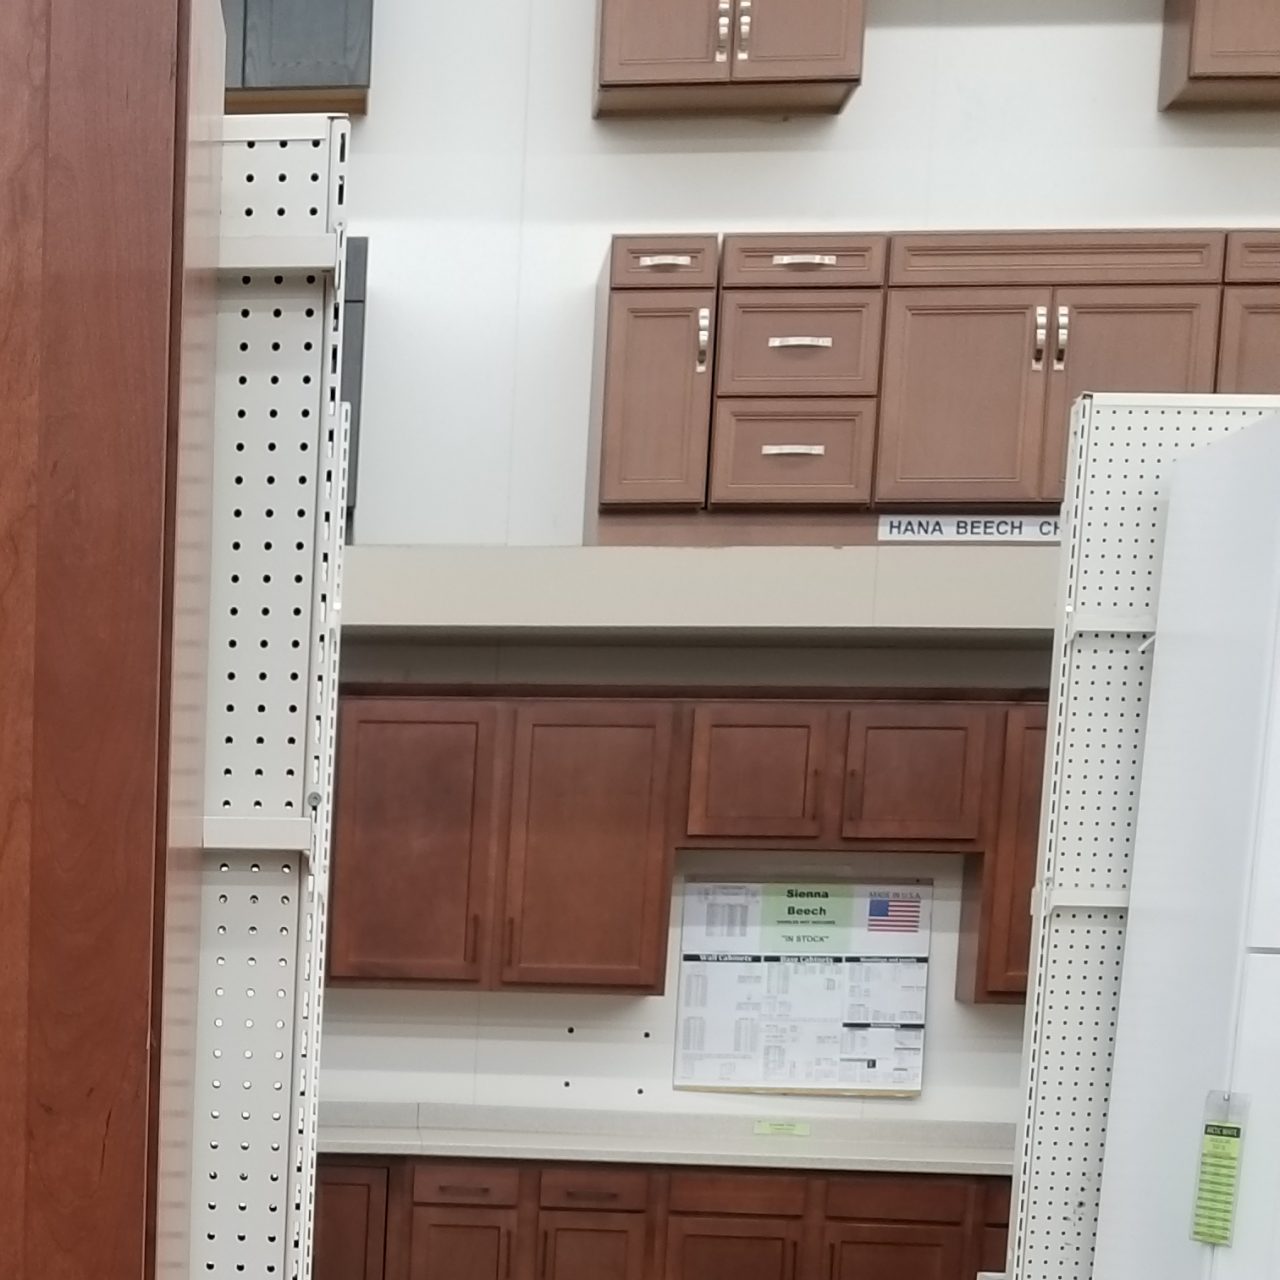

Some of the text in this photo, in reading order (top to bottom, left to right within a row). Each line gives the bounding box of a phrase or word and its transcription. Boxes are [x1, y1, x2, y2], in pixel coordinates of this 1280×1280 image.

[889, 520, 944, 535] HANA
[956, 520, 1023, 535] BEECH
[786, 889, 829, 898] Sienna
[787, 906, 826, 916] Beech
